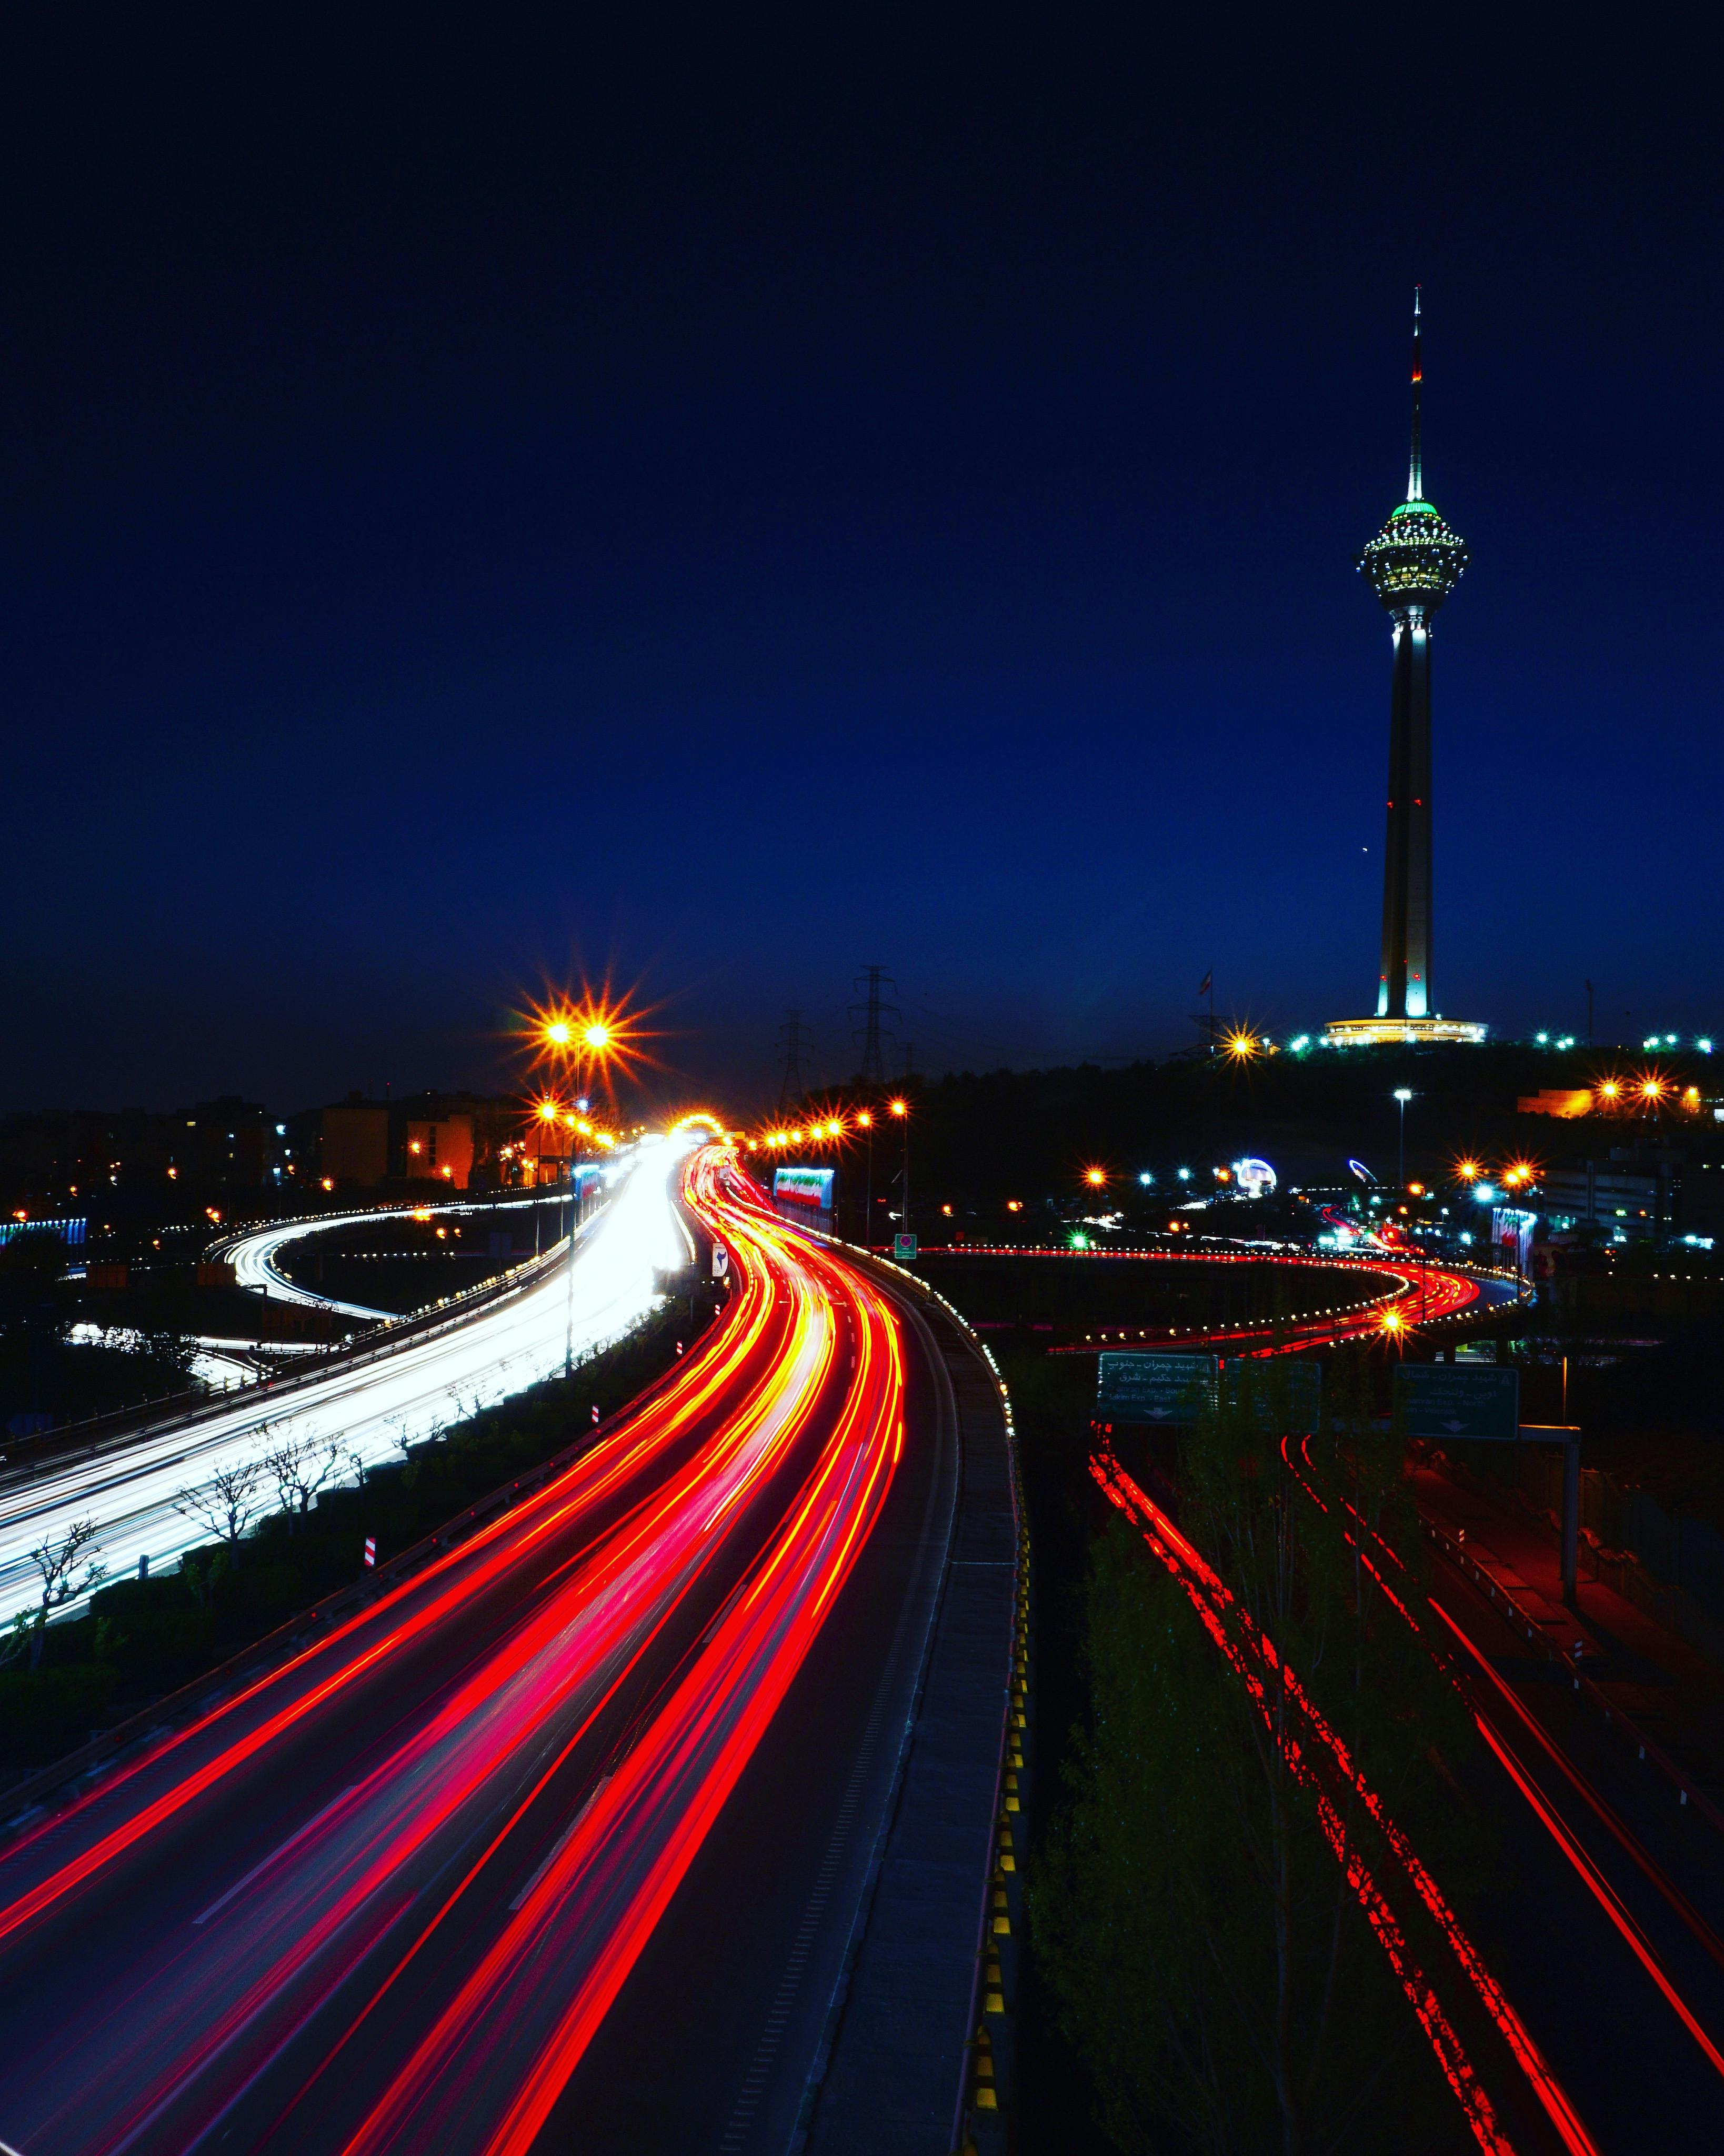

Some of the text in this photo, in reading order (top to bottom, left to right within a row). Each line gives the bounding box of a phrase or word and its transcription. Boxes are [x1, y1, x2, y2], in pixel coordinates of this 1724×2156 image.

[1107, 1360, 1135, 1370] جنوب
[1144, 1360, 1172, 1371] چمران
[1119, 1372, 1141, 1383] شرق
[1149, 1373, 1171, 1385] حکیم
[1401, 1370, 1429, 1380] شمال
[1439, 1372, 1468, 1384] چمران
